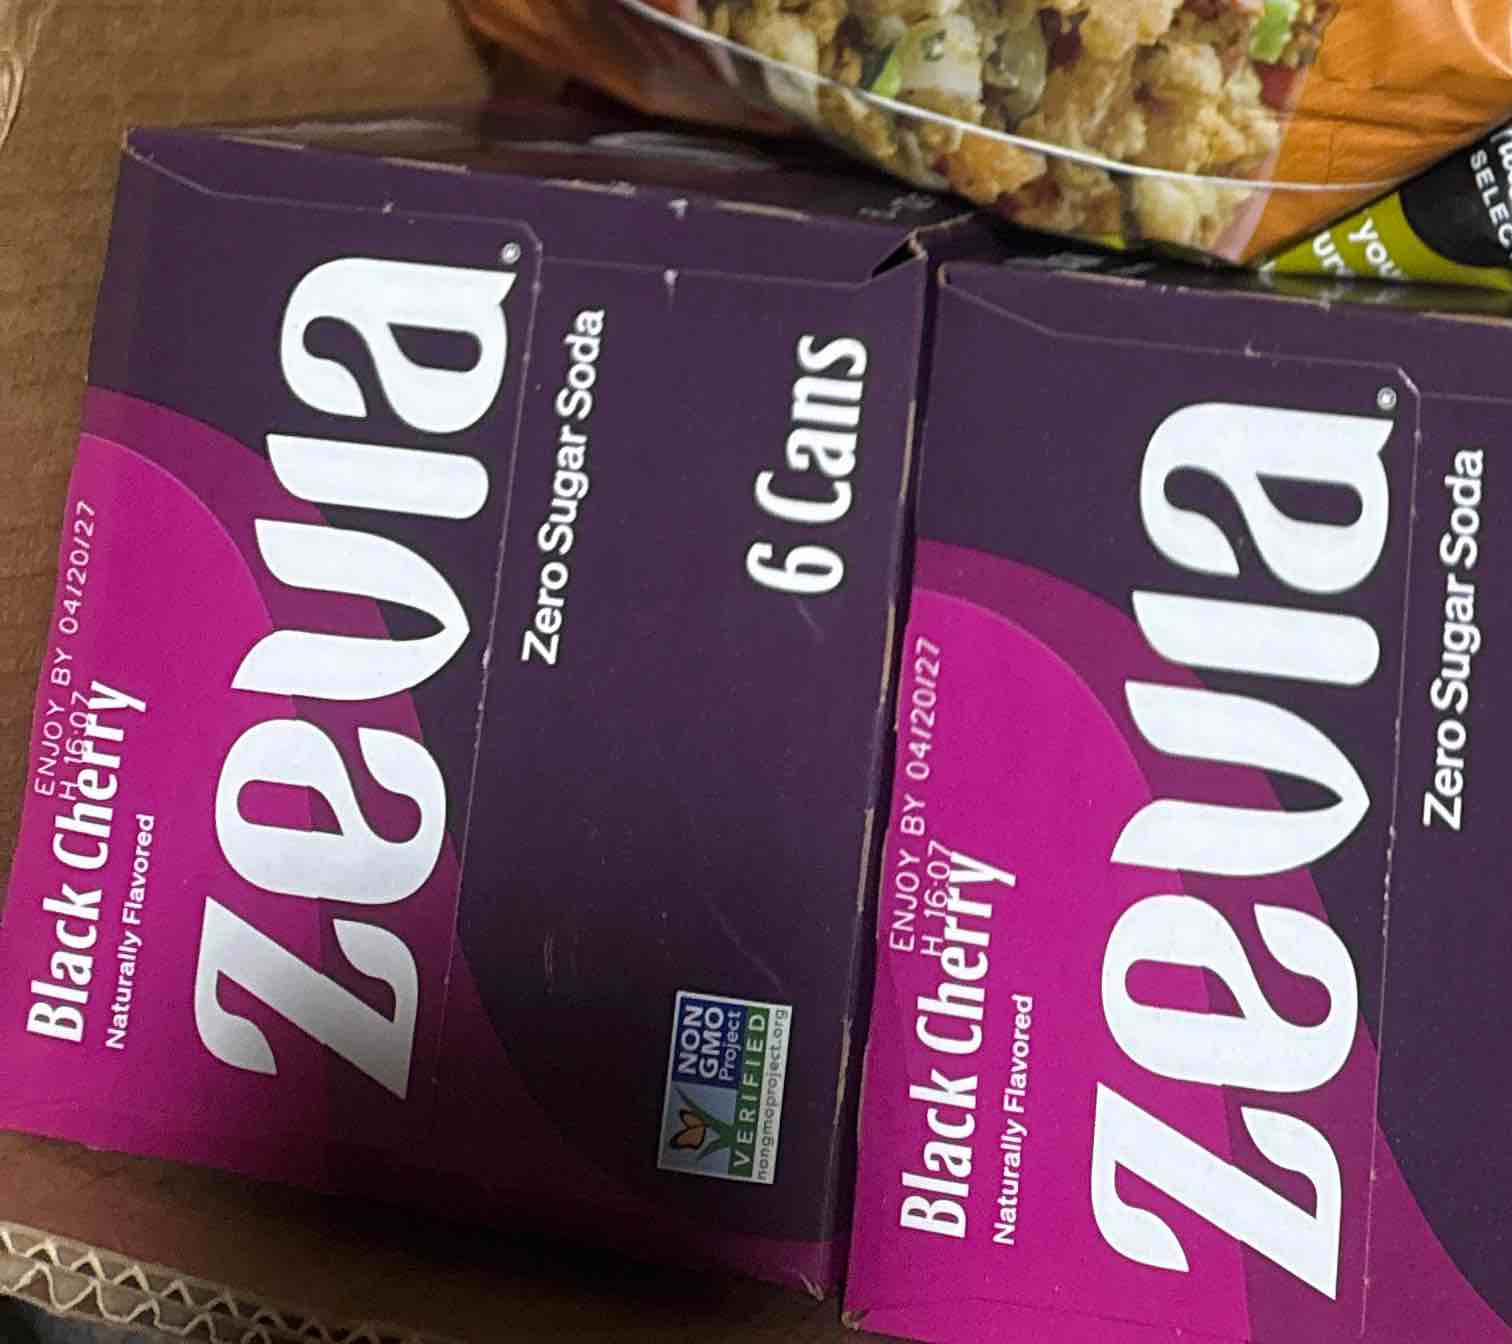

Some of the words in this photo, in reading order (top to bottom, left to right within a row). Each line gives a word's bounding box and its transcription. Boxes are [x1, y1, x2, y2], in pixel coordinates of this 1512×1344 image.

[561, 310, 606, 419] Soda
[537, 423, 590, 554] Sugar
[753, 333, 867, 533] Cans
[59, 500, 96, 634] 04/20/27
[747, 540, 845, 595] 6
[1438, 449, 1484, 569] Soda
[52, 647, 73, 687] BY
[521, 558, 572, 666] Zero
[1429, 577, 1479, 713] Sugar
[35, 703, 64, 797] ENJOY
[907, 637, 940, 782] 04/20/27
[52, 679, 147, 870] Cherry
[903, 795, 926, 837] BY
[1423, 720, 1467, 832] Zero
[105, 927, 142, 1050] Naturally
[134, 813, 155, 922] Flavored
[890, 849, 921, 953] ENJOY
[916, 851, 1016, 1057] Cherry
[27, 886, 102, 1044] Black
[679, 1005, 703, 1075] NON
[700, 1007, 724, 1079] GMO
[719, 1011, 742, 1081] Project
[733, 1014, 765, 1167] VERIFIED
[900, 1070, 978, 1239] Black
[993, 1120, 1026, 1247] Naturally
[1012, 994, 1033, 1113] Flavored
